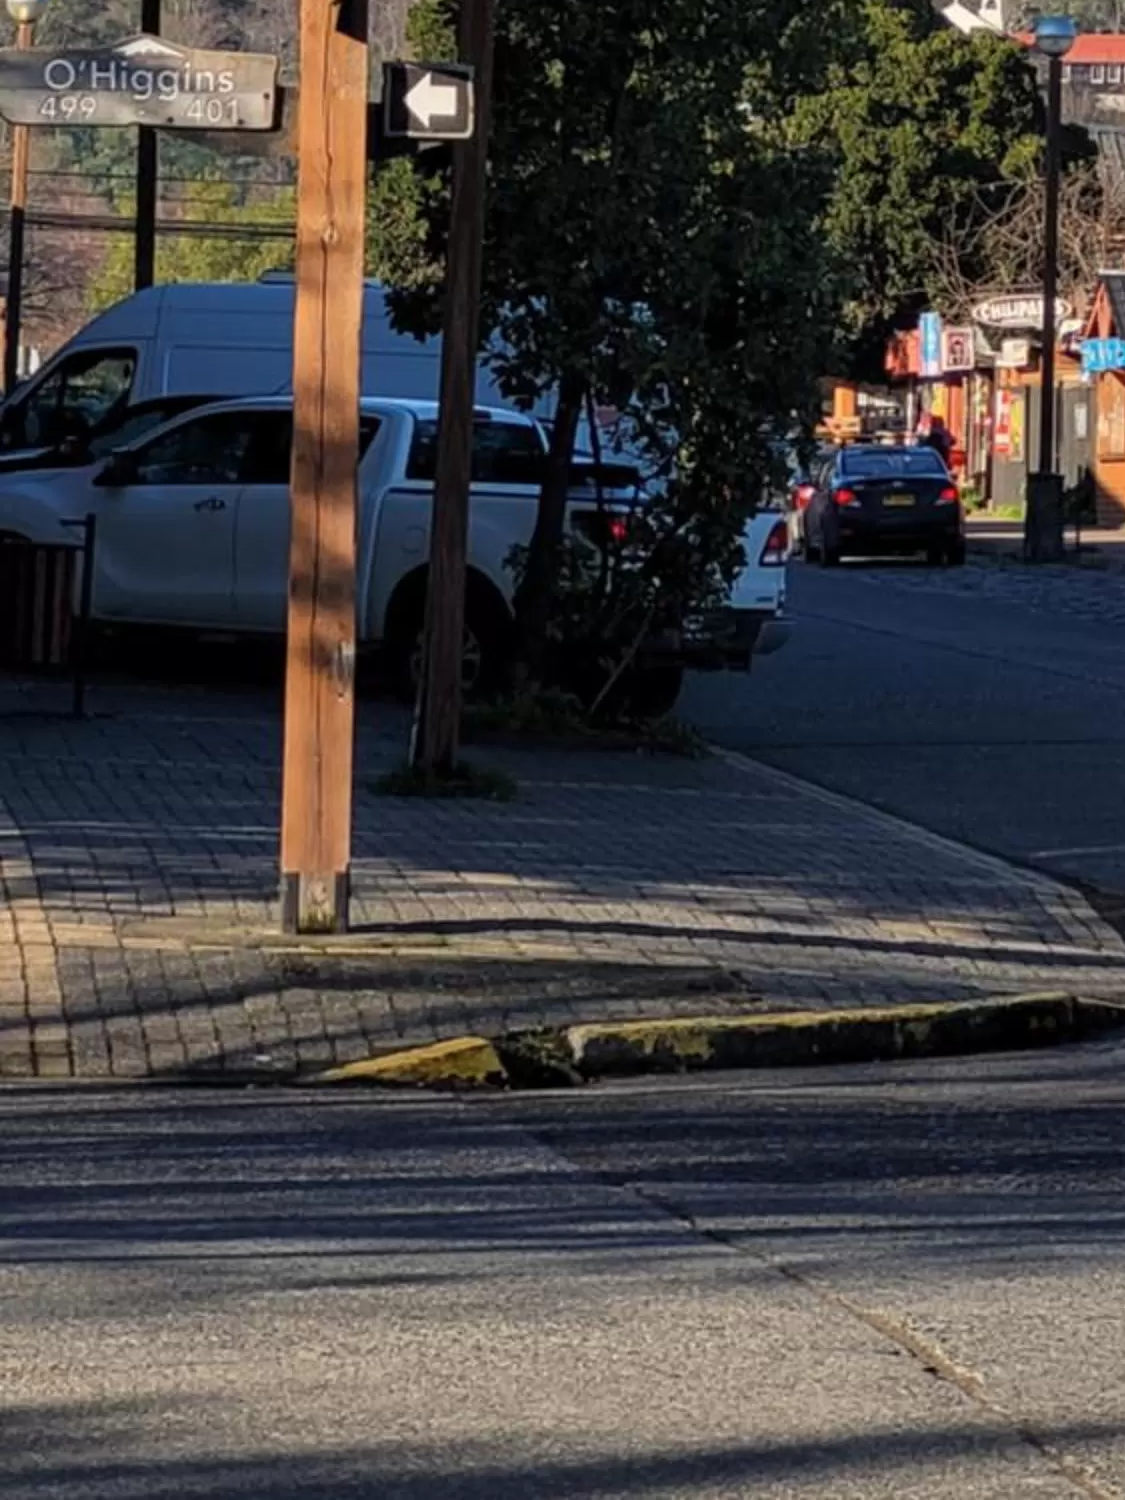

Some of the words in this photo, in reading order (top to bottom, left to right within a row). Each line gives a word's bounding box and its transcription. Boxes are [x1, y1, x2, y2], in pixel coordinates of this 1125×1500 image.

[44, 58, 235, 101] O'Higgins
[40, 96, 97, 120] 499
[187, 98, 239, 124] 401
